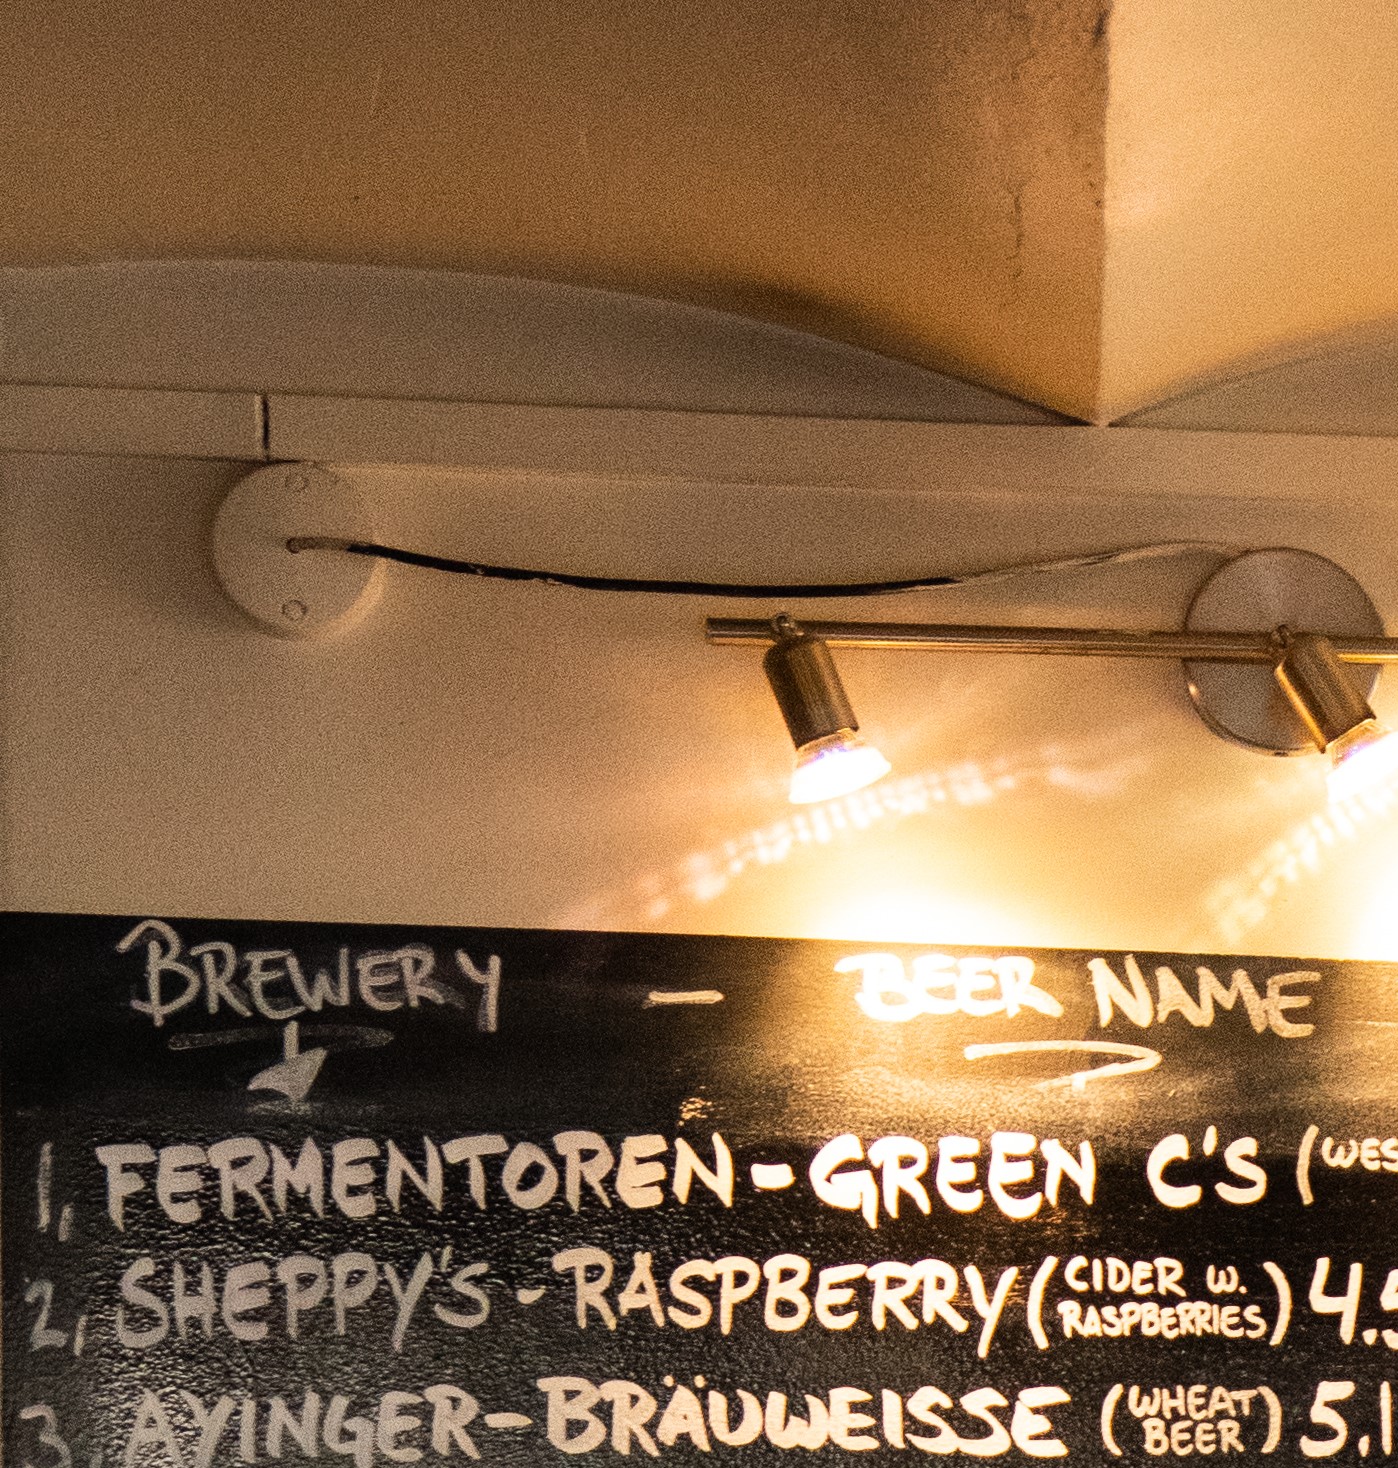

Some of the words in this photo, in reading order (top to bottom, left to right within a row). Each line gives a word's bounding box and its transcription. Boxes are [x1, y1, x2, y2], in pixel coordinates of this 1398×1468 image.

[118, 919, 501, 1032] BREWERY
[835, 953, 1064, 1022] BEER
[1089, 954, 1320, 1038] NAME
[809, 1131, 1097, 1229] GREEN
[1064, 1256, 1186, 1298] CIDER
[1057, 1301, 1268, 1341] RASPBERRIES
[1128, 1383, 1258, 1420] WHEAT
[1142, 1418, 1244, 1456] BEER
